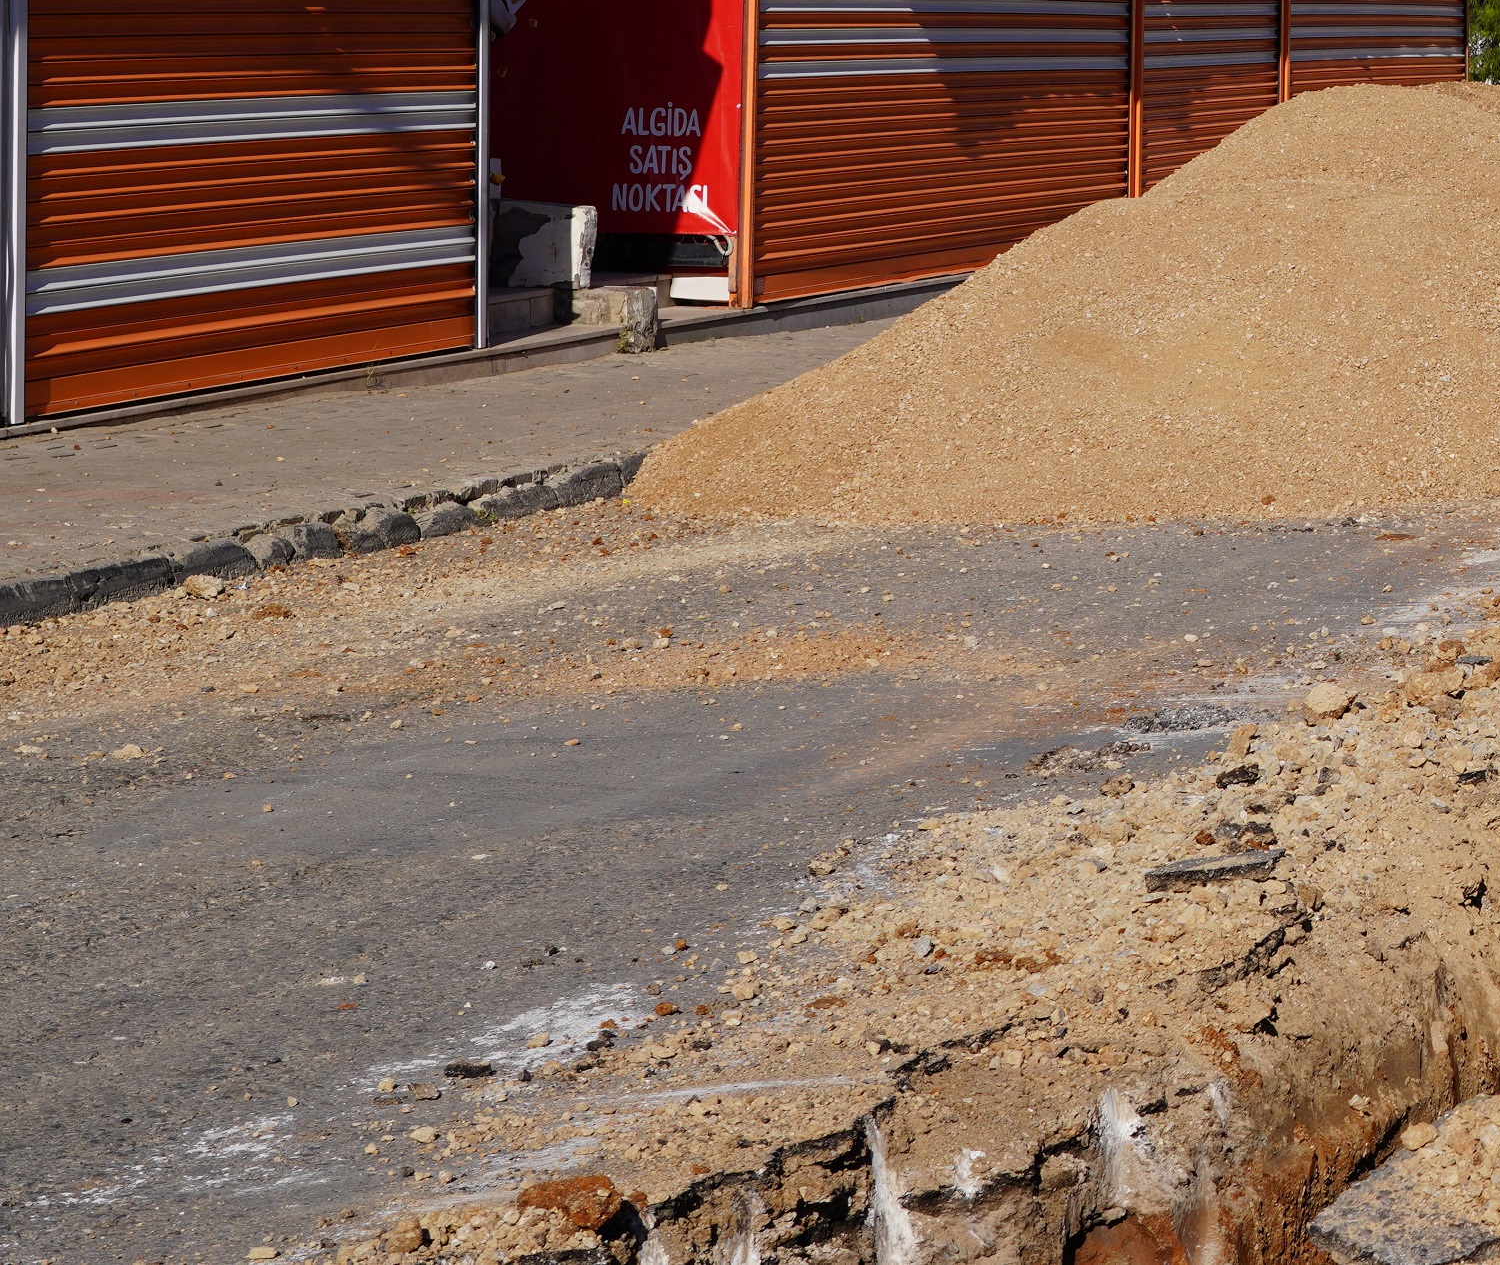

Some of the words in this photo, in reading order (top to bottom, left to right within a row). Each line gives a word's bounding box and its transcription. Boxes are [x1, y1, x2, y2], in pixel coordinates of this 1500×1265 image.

[621, 102, 701, 136] ALGİDA
[629, 145, 692, 180] SATIŞ
[611, 183, 708, 214] NOKTASI
